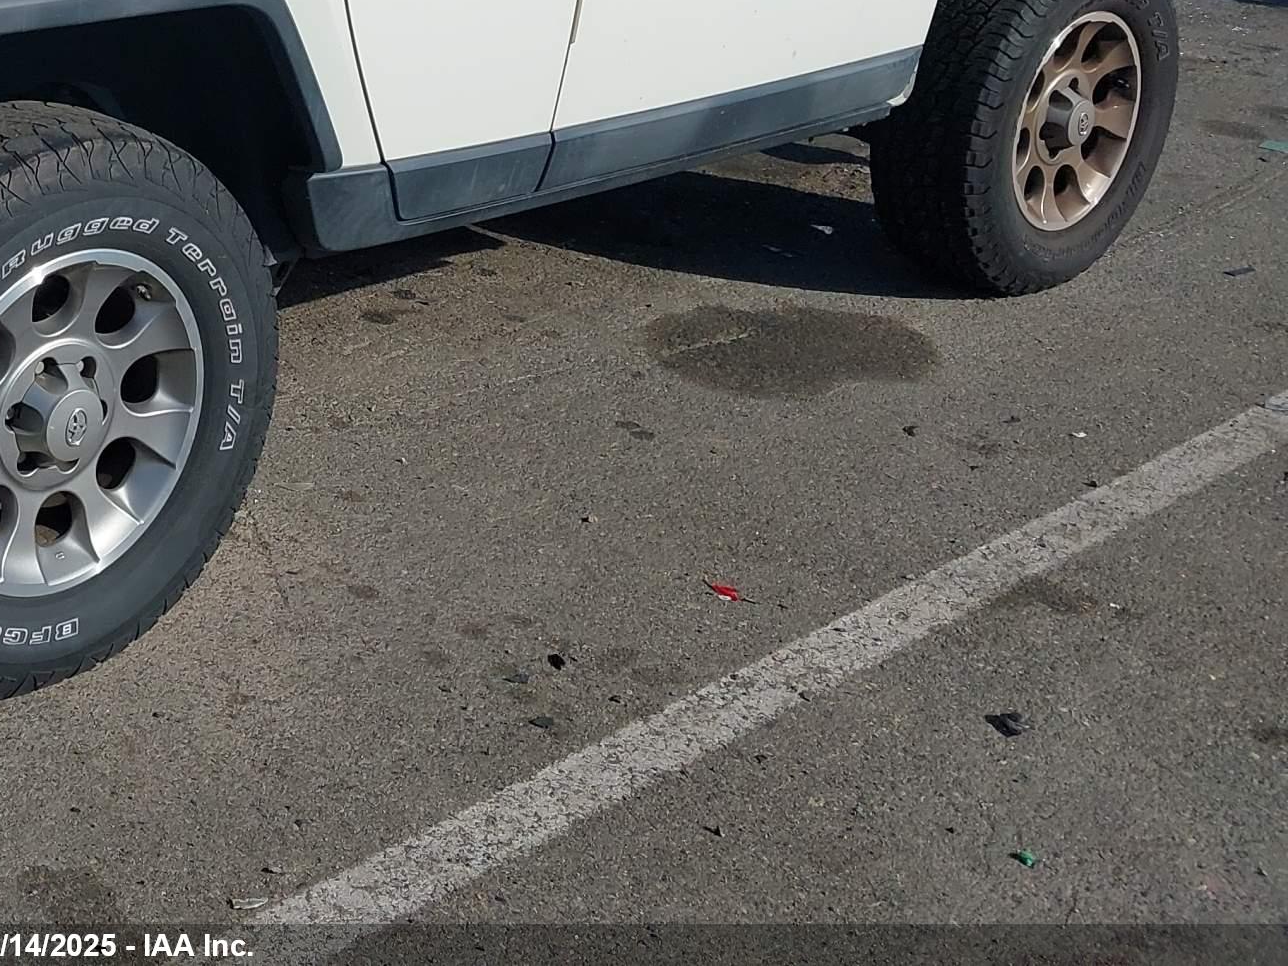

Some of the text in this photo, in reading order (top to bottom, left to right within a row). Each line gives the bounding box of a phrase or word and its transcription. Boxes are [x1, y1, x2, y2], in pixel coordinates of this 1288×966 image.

[0, 215, 246, 453] Rugged Terrain T/A
